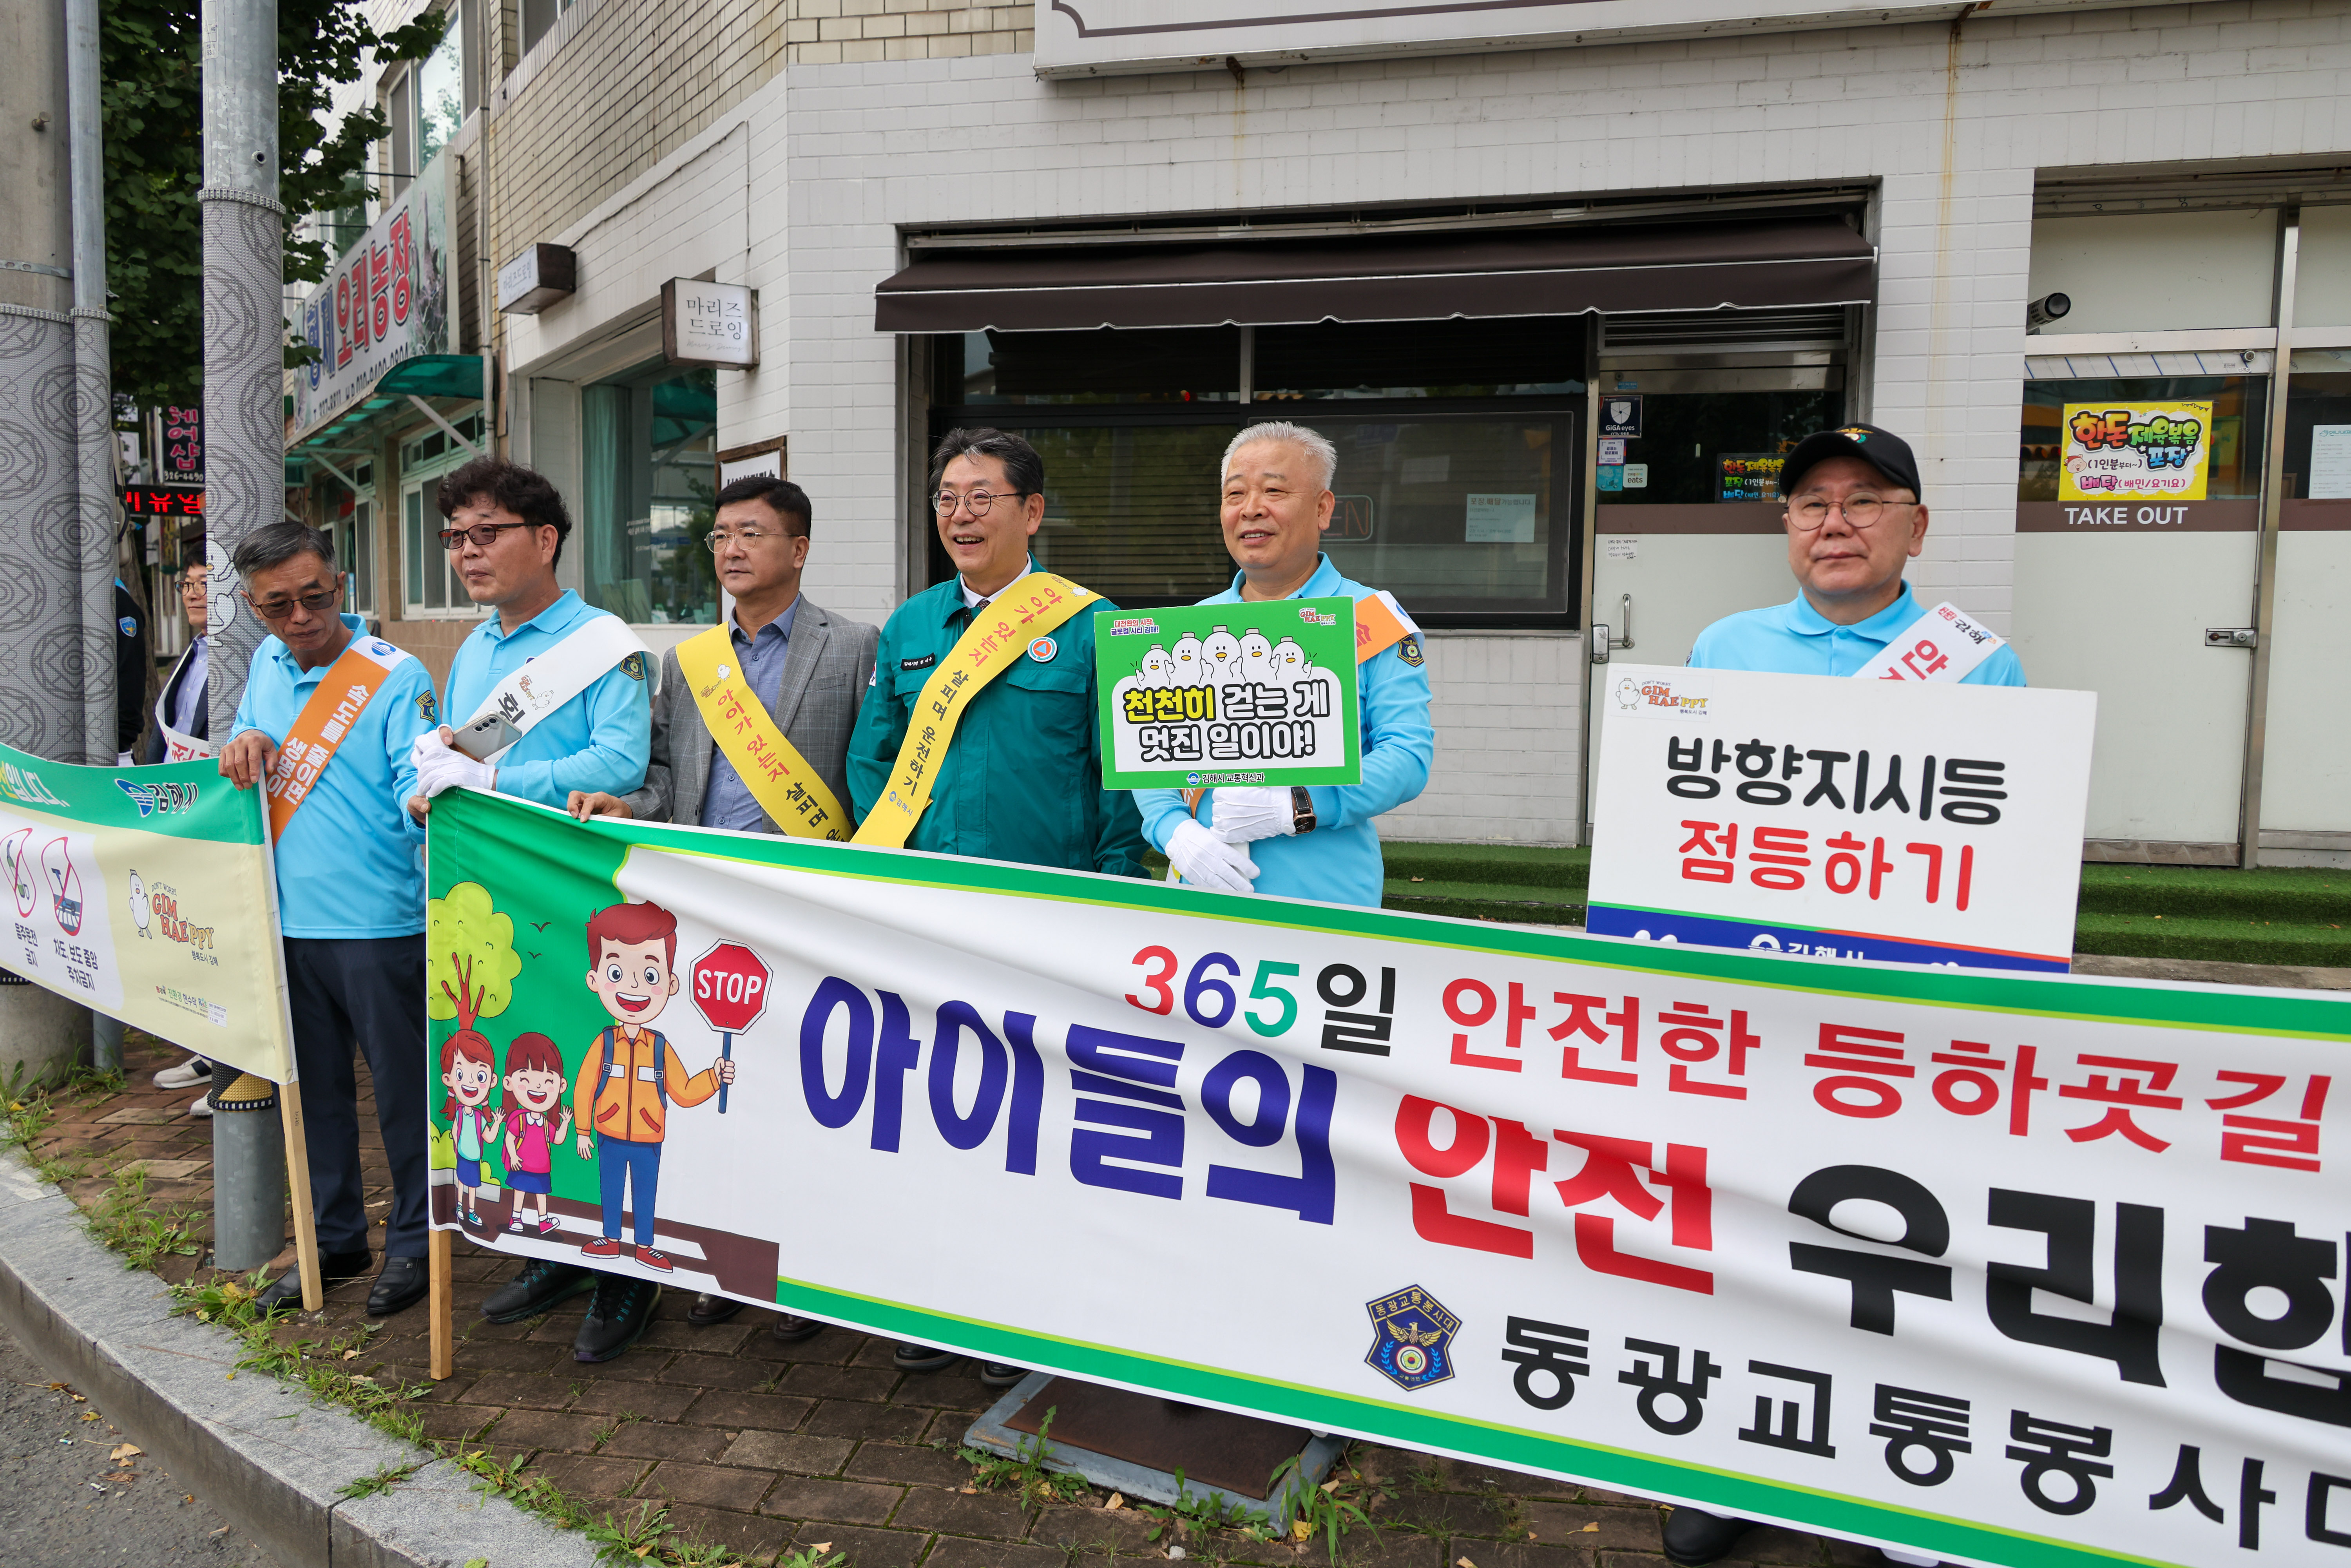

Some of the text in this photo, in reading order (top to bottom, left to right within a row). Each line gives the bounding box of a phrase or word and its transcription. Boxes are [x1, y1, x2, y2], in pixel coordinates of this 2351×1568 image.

[337, 205, 412, 371] 오리농장
[686, 296, 742, 317] 마리즈
[688, 319, 741, 340] 드로잉
[2070, 411, 2200, 449] 한돈 제육볶음
[1722, 458, 1746, 474] 한돈
[2147, 445, 2188, 467] 포장
[1722, 489, 1744, 499] 배달
[1724, 476, 1744, 487] 포장
[2080, 474, 2118, 491] 배달
[2065, 507, 2188, 525] TAKE OUT
[1014, 587, 1062, 625] 아이가
[1114, 618, 1154, 628] 대전환의 시작,
[1954, 619, 1987, 645] 김해
[968, 621, 1016, 668] 있는지
[521, 676, 530, 687] GIM
[932, 669, 969, 722] 살피며
[1641, 685, 1670, 697] GIM
[320, 684, 370, 744] 속도를
[1123, 679, 1330, 724] 천천히 걷는 게
[1139, 720, 1316, 762] 멋진 일이야!
[266, 737, 308, 798] 생명이
[717, 688, 753, 735] 아이가
[746, 733, 790, 782] 있는지
[786, 781, 829, 828] 살피며
[903, 725, 936, 797] 운전하기
[283, 742, 330, 806] 줄이면
[1201, 772, 1264, 784] 김해시 교통혁신과
[1666, 735, 2009, 826] 방향지시등
[143, 782, 199, 815] 김해시
[896, 797, 913, 817] 김해시
[1679, 819, 1974, 912] 점등하기
[152, 882, 162, 892] DON'T
[152, 893, 178, 922] GIM
[15, 922, 38, 947] 음주운전
[25, 947, 38, 968] 금지
[53, 938, 98, 970] 차도, 보도 중앙
[191, 950, 219, 967] 행복도시 김해
[67, 965, 95, 991] 주차금지
[697, 969, 763, 1005] STOP
[168, 988, 182, 1002] 친환경
[183, 993, 197, 1008] 현수막
[1124, 945, 2332, 1173] 365일 안전한 등하굣길
[799, 975, 1338, 1226] 아이들의
[1393, 1092, 1716, 1297] 안전
[1375, 1291, 1454, 1330] 동광교통봉사대
